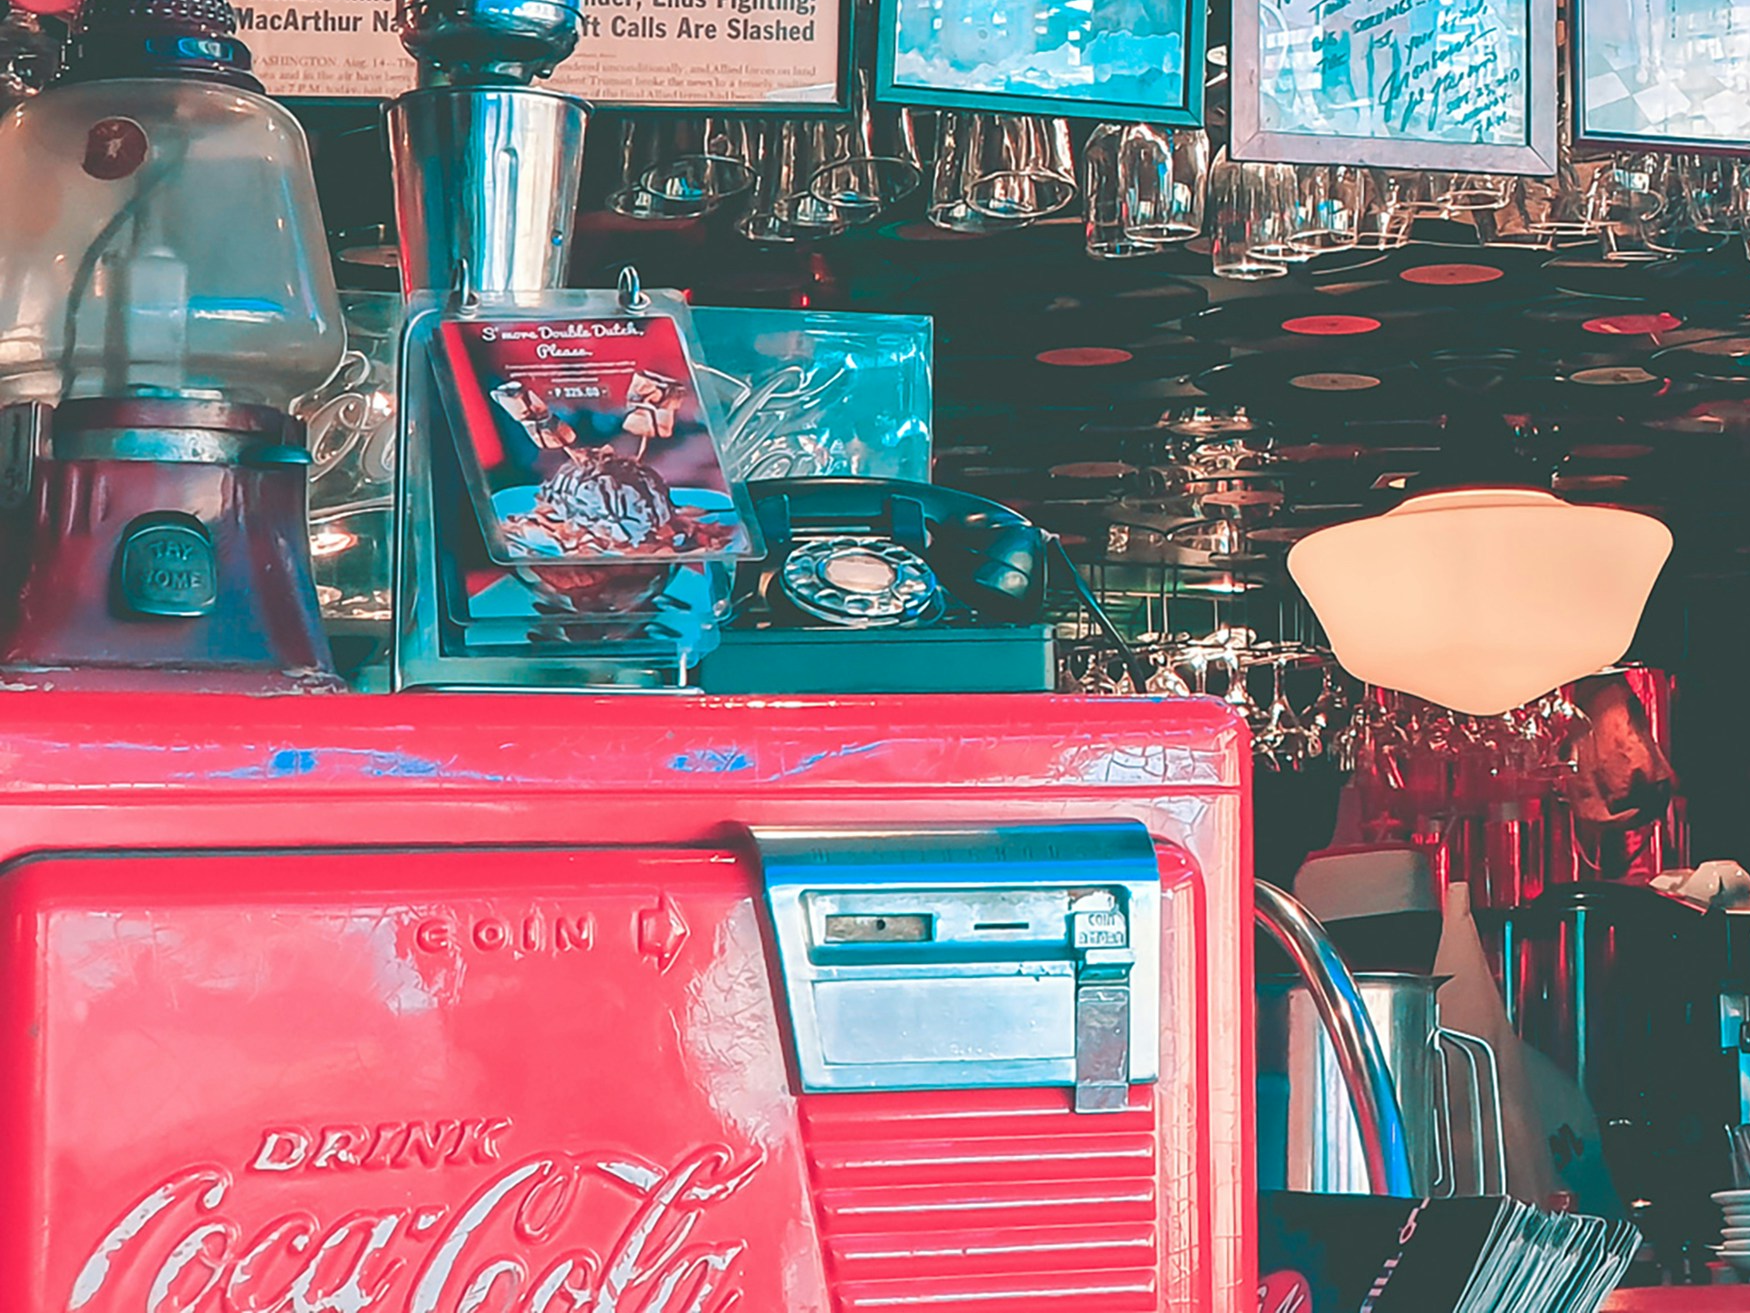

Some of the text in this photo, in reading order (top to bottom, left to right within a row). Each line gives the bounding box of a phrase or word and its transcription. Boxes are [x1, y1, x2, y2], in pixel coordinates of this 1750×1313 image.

[235, 6, 363, 33] MacArthur
[611, 15, 667, 40] Calls
[677, 17, 718, 40] Are
[727, 18, 815, 42] Slashed
[537, 324, 591, 340] Double
[413, 912, 600, 956] COIN
[246, 1116, 514, 1177] DRINK
